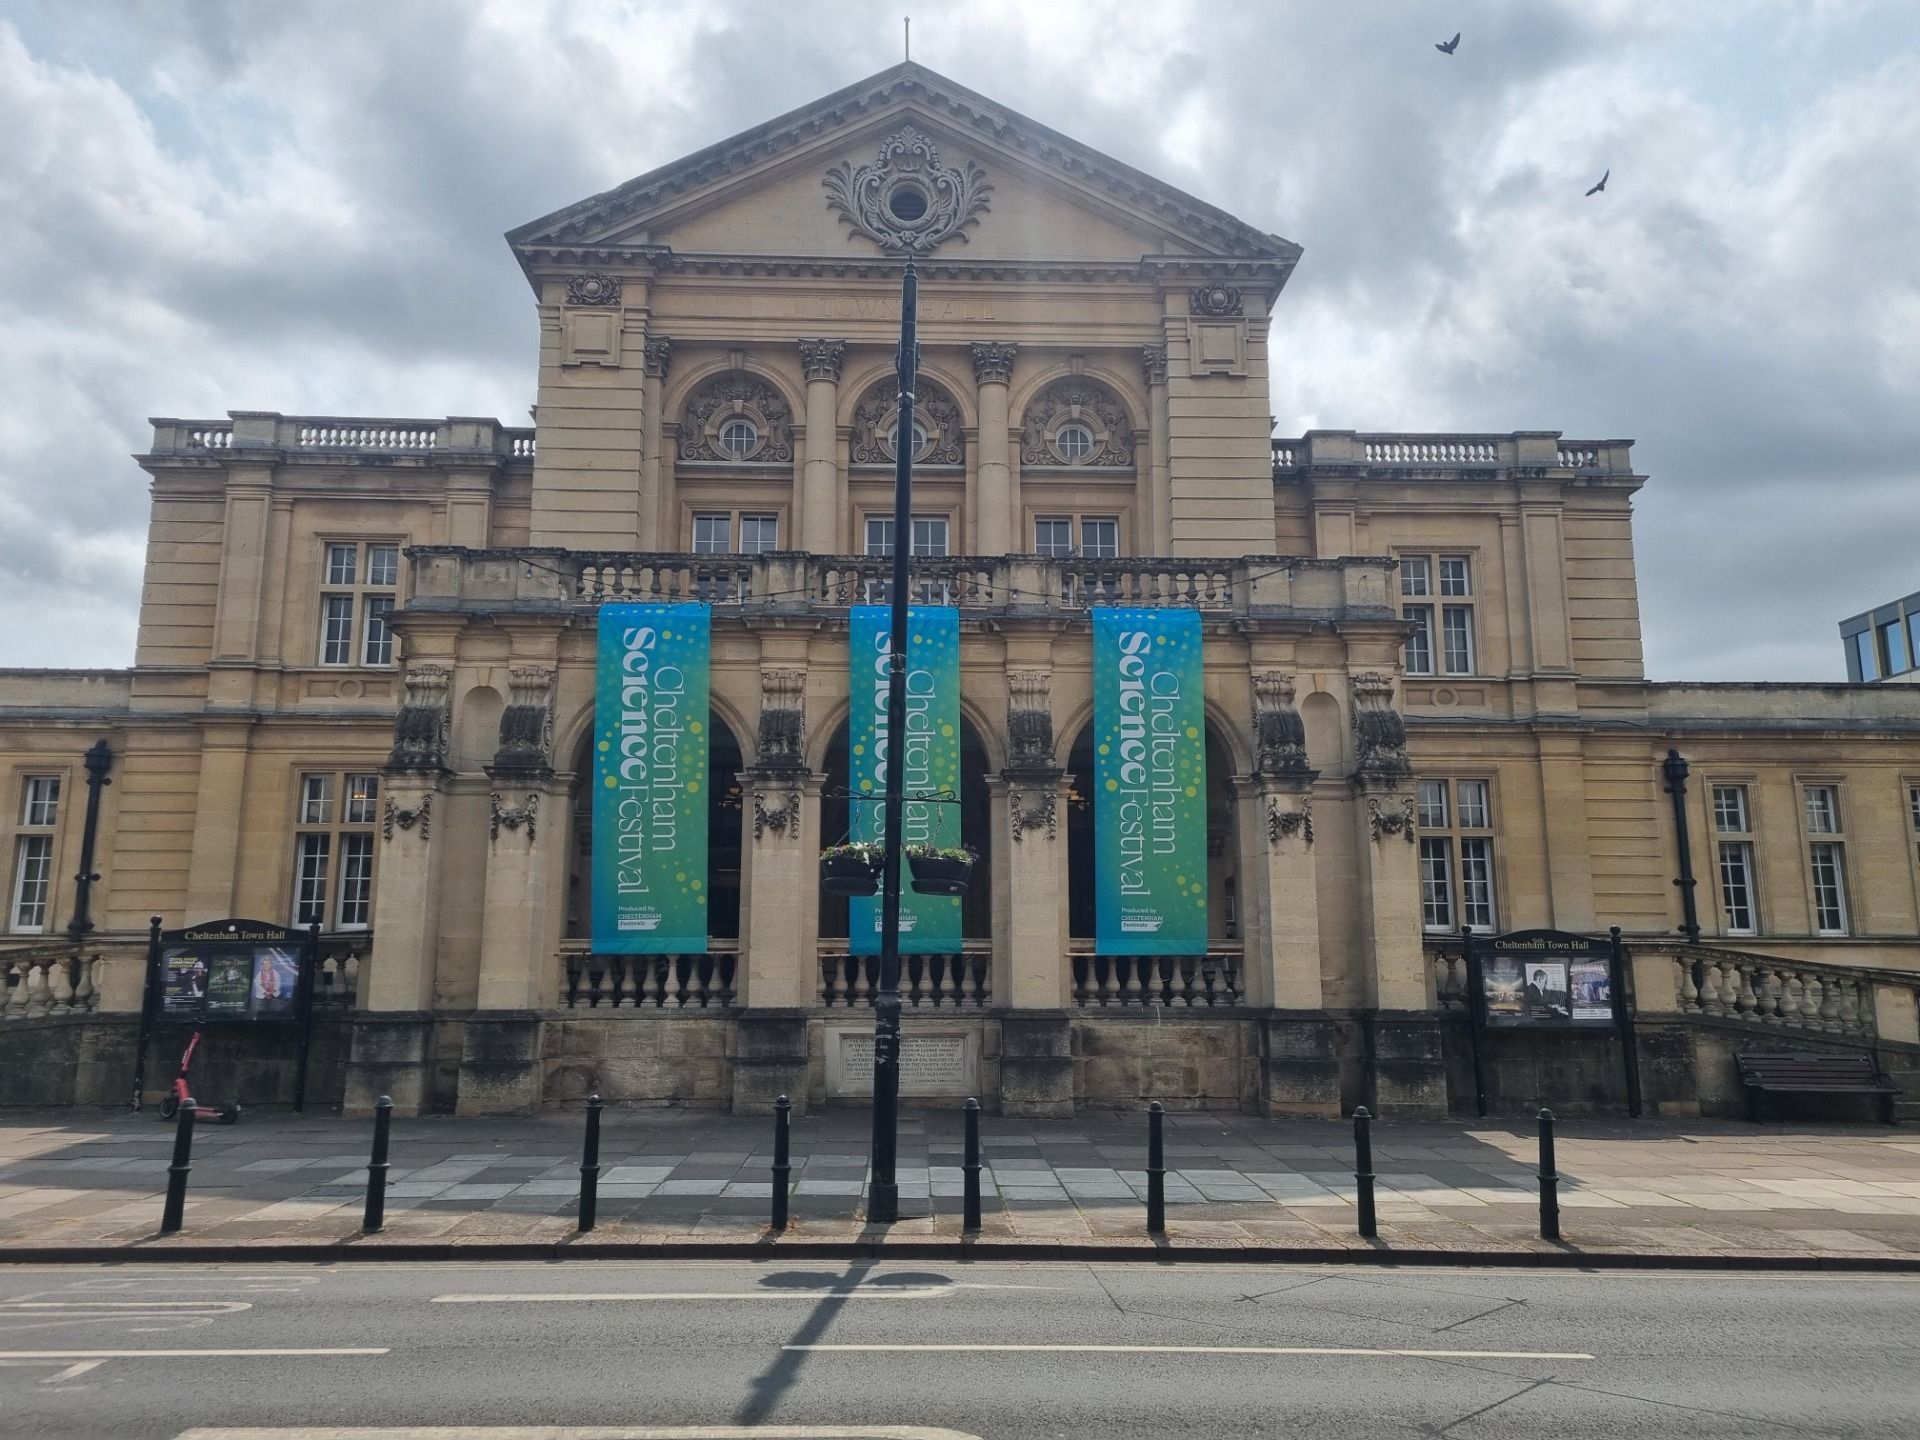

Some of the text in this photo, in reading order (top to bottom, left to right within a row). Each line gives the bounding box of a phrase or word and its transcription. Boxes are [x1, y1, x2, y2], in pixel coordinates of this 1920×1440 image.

[820, 297, 996, 320] TOWN HALL
[618, 627, 656, 894] Science Festival
[653, 666, 685, 852] Cheltenham
[905, 670, 937, 846] Cheltenham
[1119, 631, 1152, 896] Science Festival
[1150, 671, 1182, 855] Cheltenham
[184, 930, 285, 940] Cheltenham Town Hall
[1495, 940, 1589, 950] Cheltenham Town Hall
